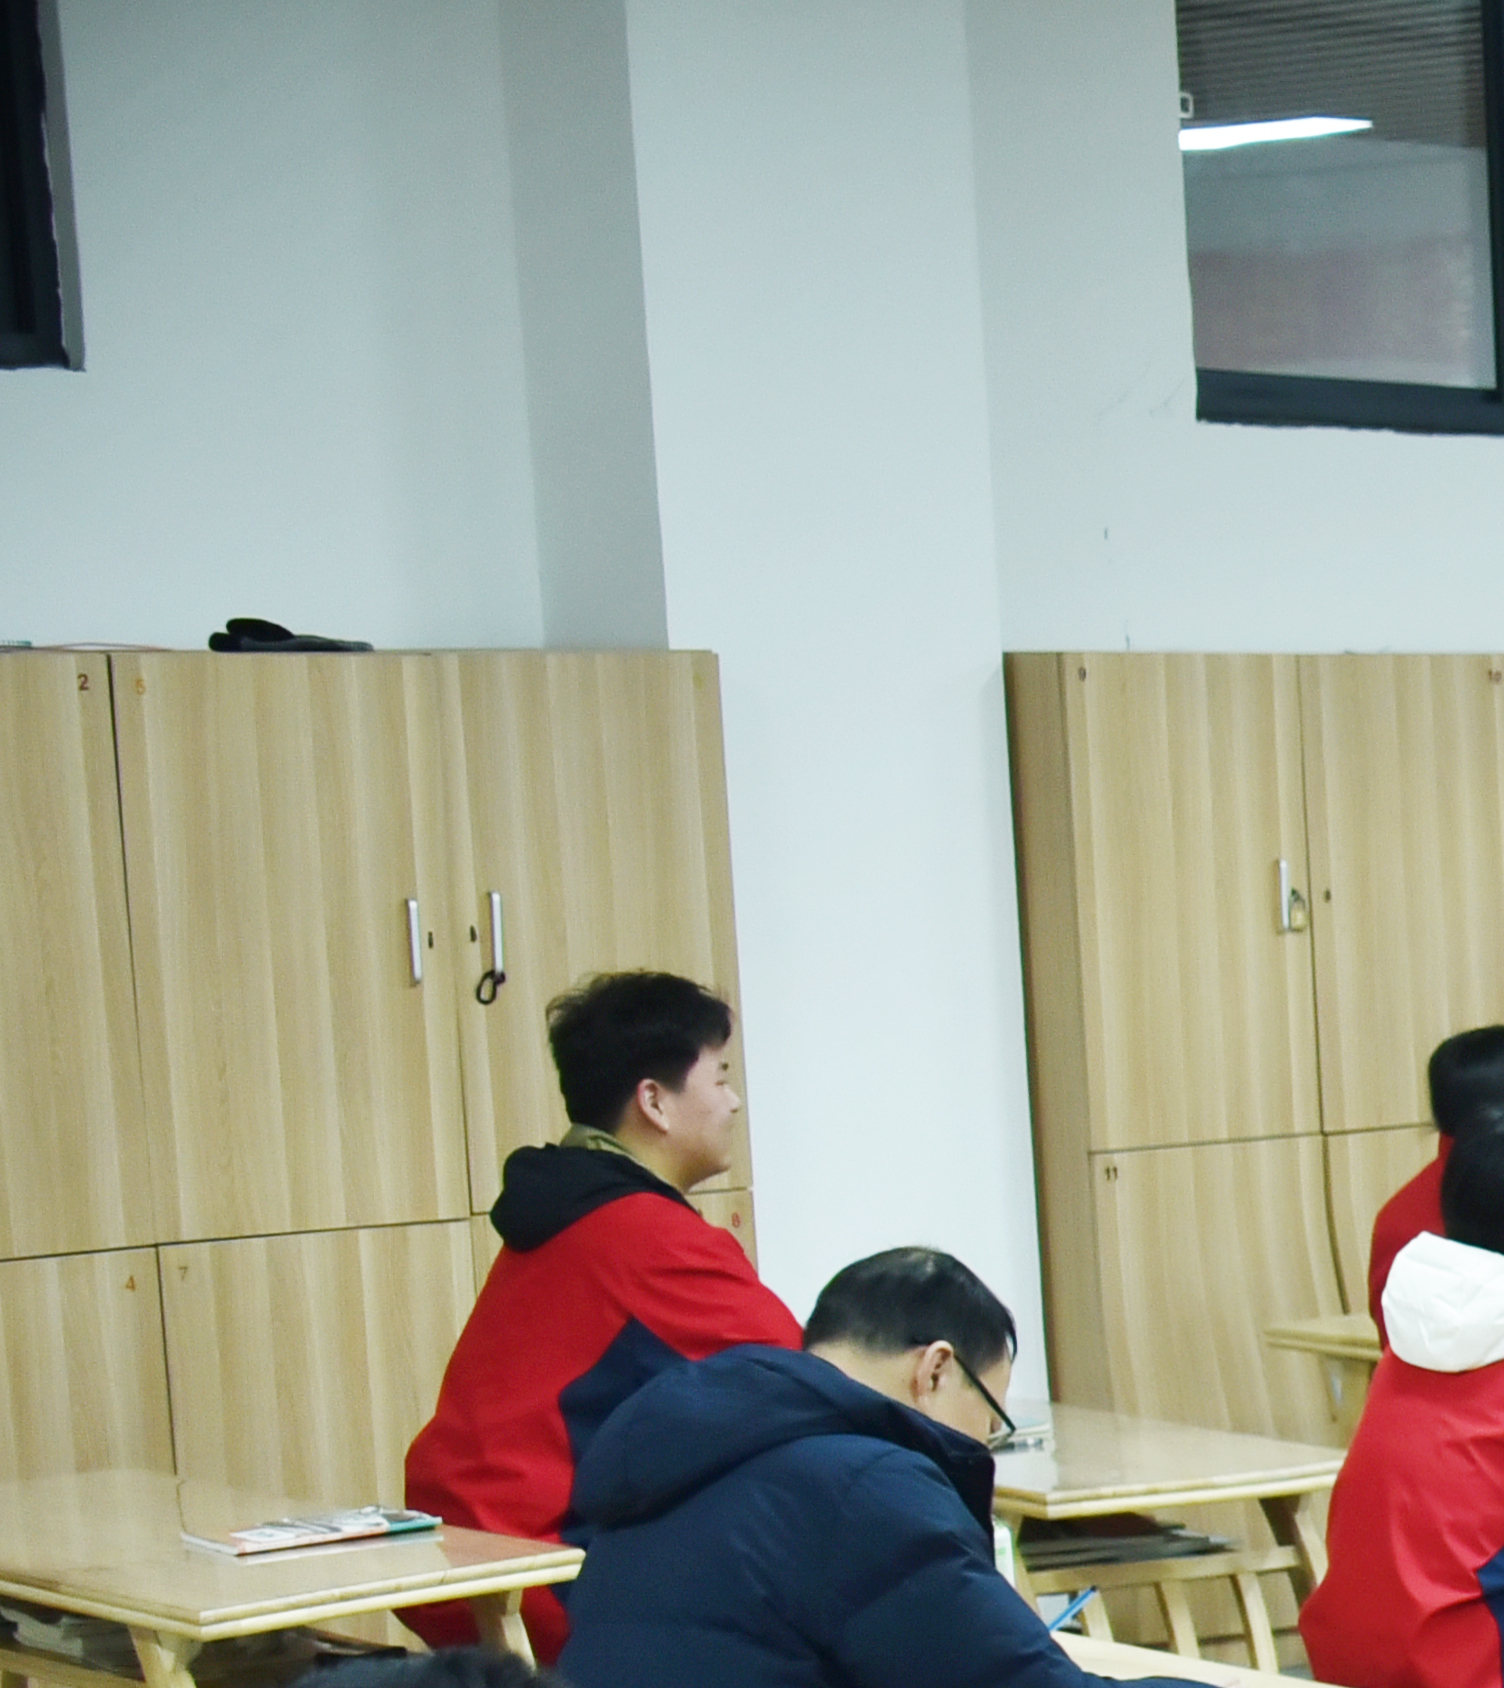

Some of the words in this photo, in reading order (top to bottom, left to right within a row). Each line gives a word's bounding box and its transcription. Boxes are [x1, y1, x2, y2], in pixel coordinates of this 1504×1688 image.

[77, 673, 90, 691] 2
[178, 1266, 189, 1282] 7
[125, 1275, 137, 1292] 4
